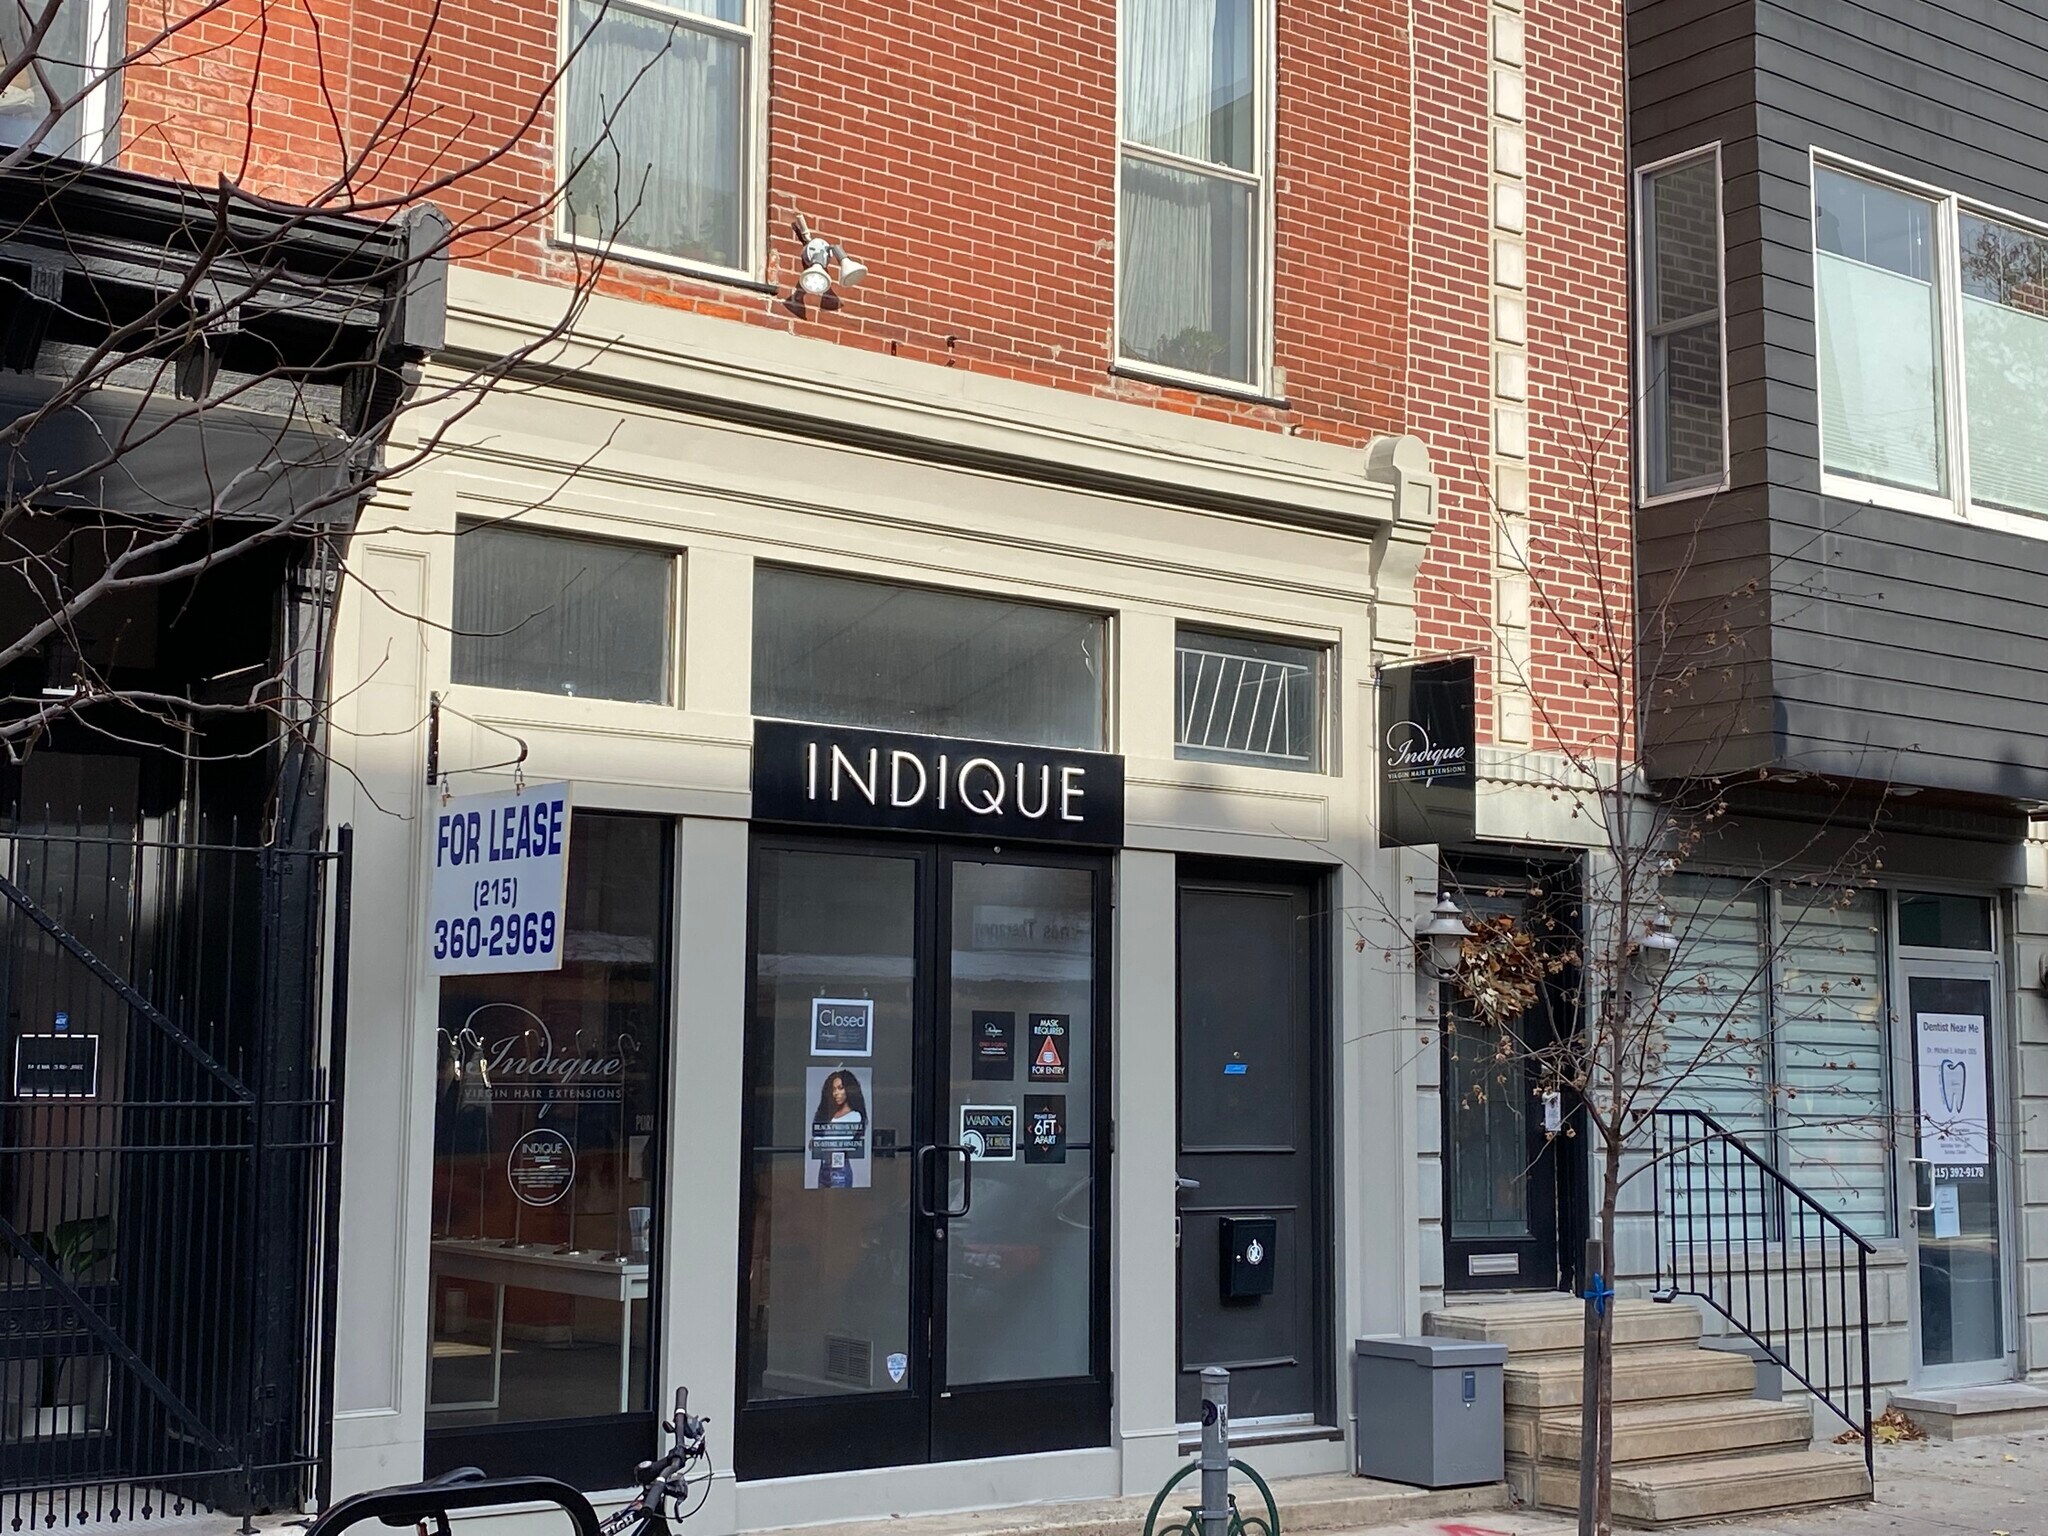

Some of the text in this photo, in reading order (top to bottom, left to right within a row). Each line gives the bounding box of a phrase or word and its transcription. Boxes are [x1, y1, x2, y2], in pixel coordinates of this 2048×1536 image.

[1386, 720, 1466, 788] Indique
[1411, 769, 1426, 779] HAIR
[1427, 766, 1466, 777] EXTENSIONS
[808, 742, 1086, 822] INDIQUE
[437, 800, 564, 867] FOR LEASE
[473, 877, 518, 912] (215)
[433, 910, 556, 960] 360-2969
[819, 1009, 866, 1028] Closed
[1040, 1019, 1059, 1028] MASK
[1034, 1026, 1065, 1036] REQUIRED
[1923, 1021, 1979, 1034] Dentist Near Me
[465, 1002, 623, 1119] Indique
[1032, 1065, 1066, 1076] FOR ENTRY
[465, 1088, 622, 1099] VIRGIN HAIR EXTENSIONS
[965, 1115, 1012, 1127] WARNING
[1034, 1119, 1057, 1136] 6FT
[1034, 1135, 1056, 1145] APART
[522, 1142, 564, 1155] INDIQUE
[1928, 1167, 1984, 1180] (15) 392-9178
